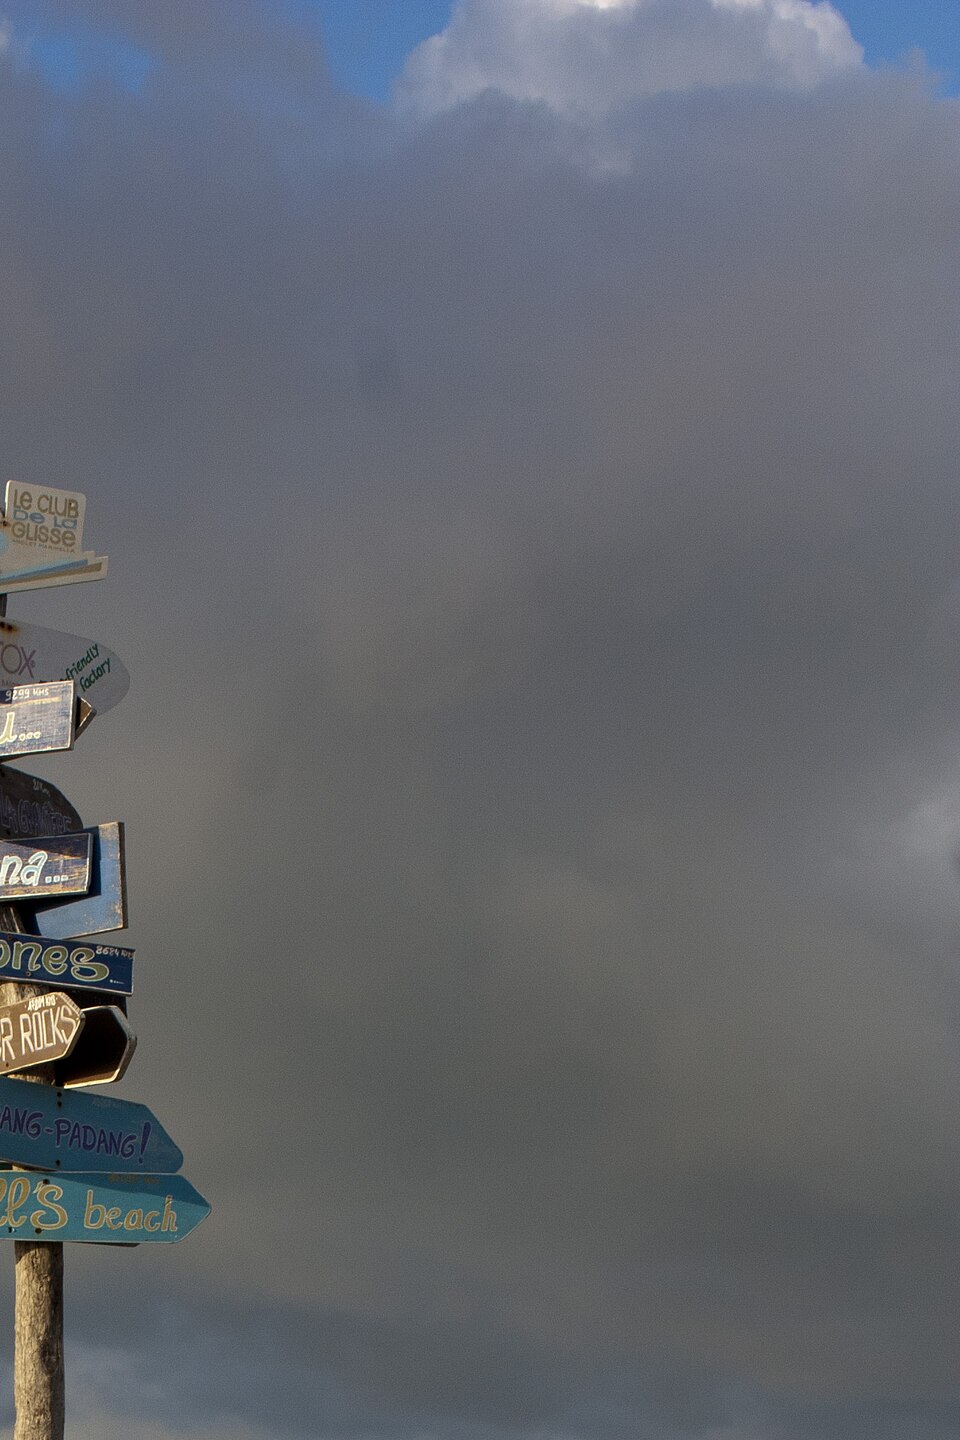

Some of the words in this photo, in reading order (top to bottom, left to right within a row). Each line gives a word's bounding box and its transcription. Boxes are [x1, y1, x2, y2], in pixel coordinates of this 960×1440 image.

[37, 494, 79, 518] CLUB
[80, 657, 111, 692] factory
[5, 689, 30, 702] 9299
[19, 1005, 77, 1056] ROCKS
[84, 1189, 178, 1232] beach
